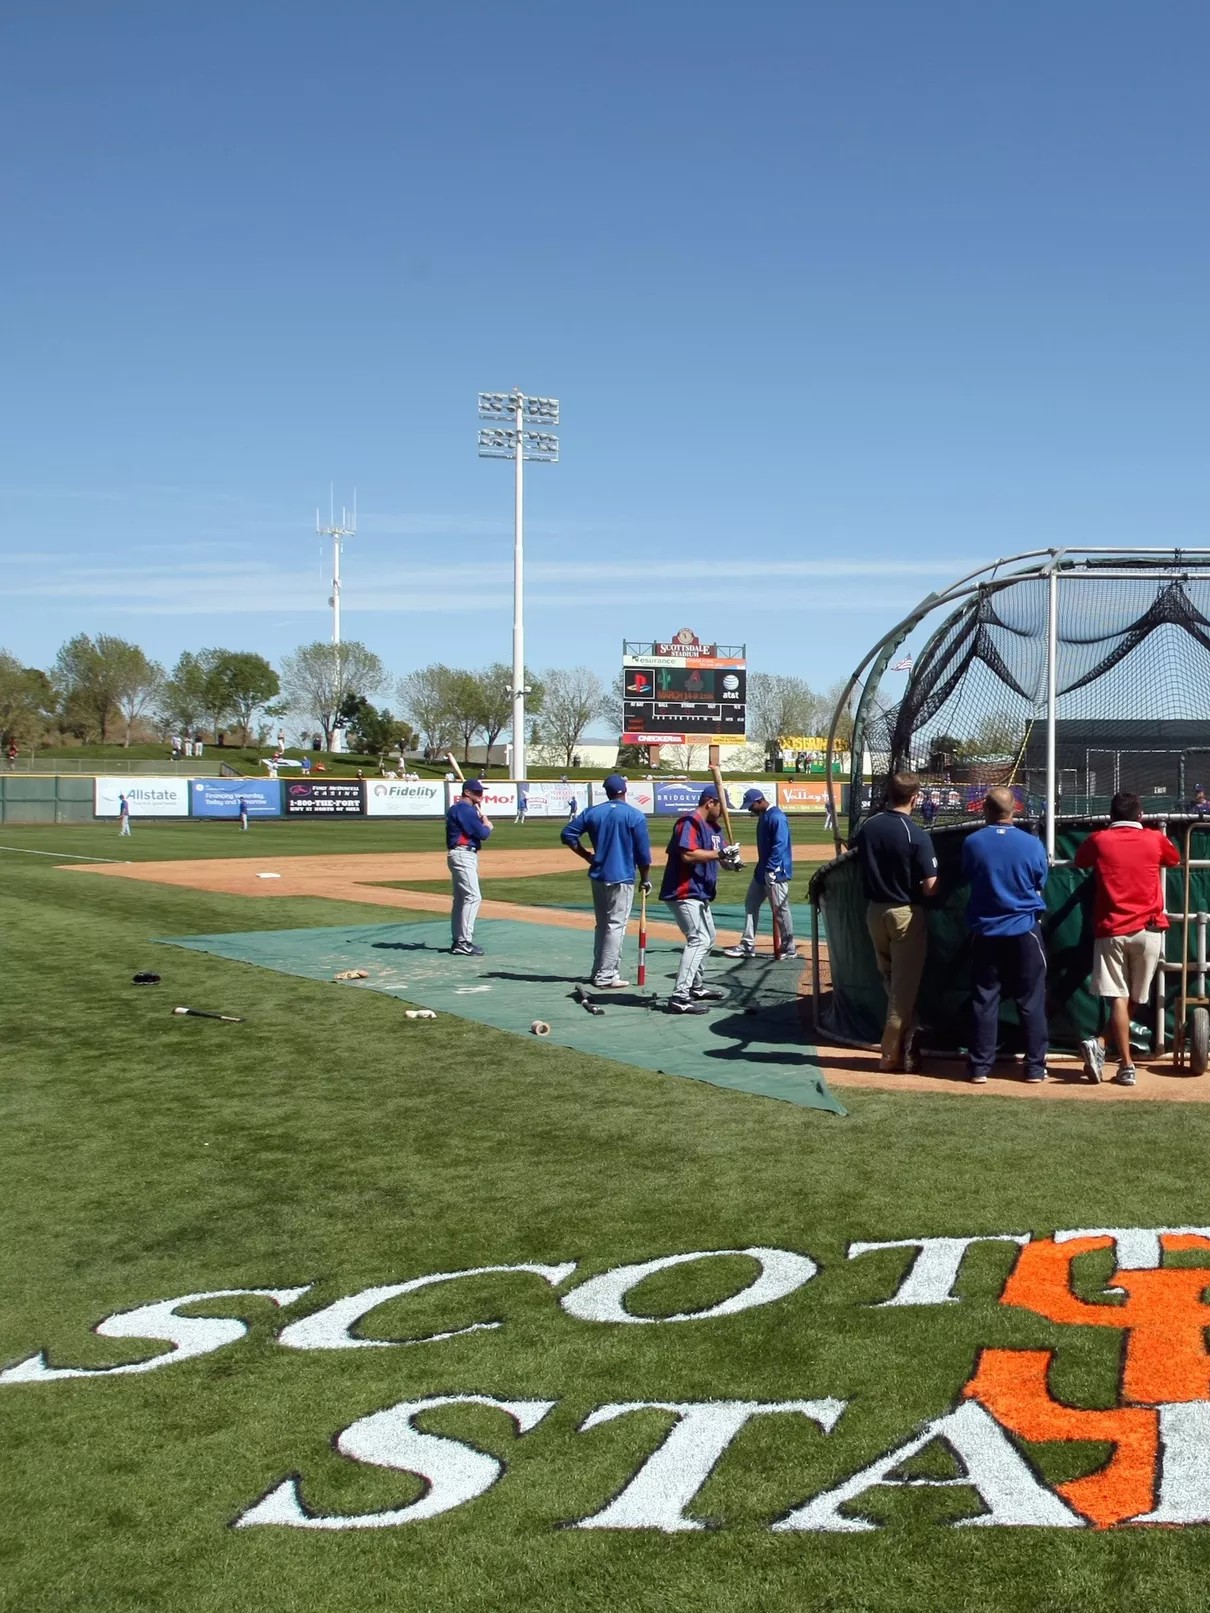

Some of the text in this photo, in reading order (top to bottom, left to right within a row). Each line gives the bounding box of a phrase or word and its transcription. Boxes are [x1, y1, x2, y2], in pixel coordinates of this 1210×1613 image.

[660, 643, 711, 655] SCOTTSDALE
[722, 691, 740, 699] at&t
[126, 789, 178, 801] Allstate
[388, 786, 438, 799] Fidelity
[289, 799, 361, 807] 1-800-THE-FORT
